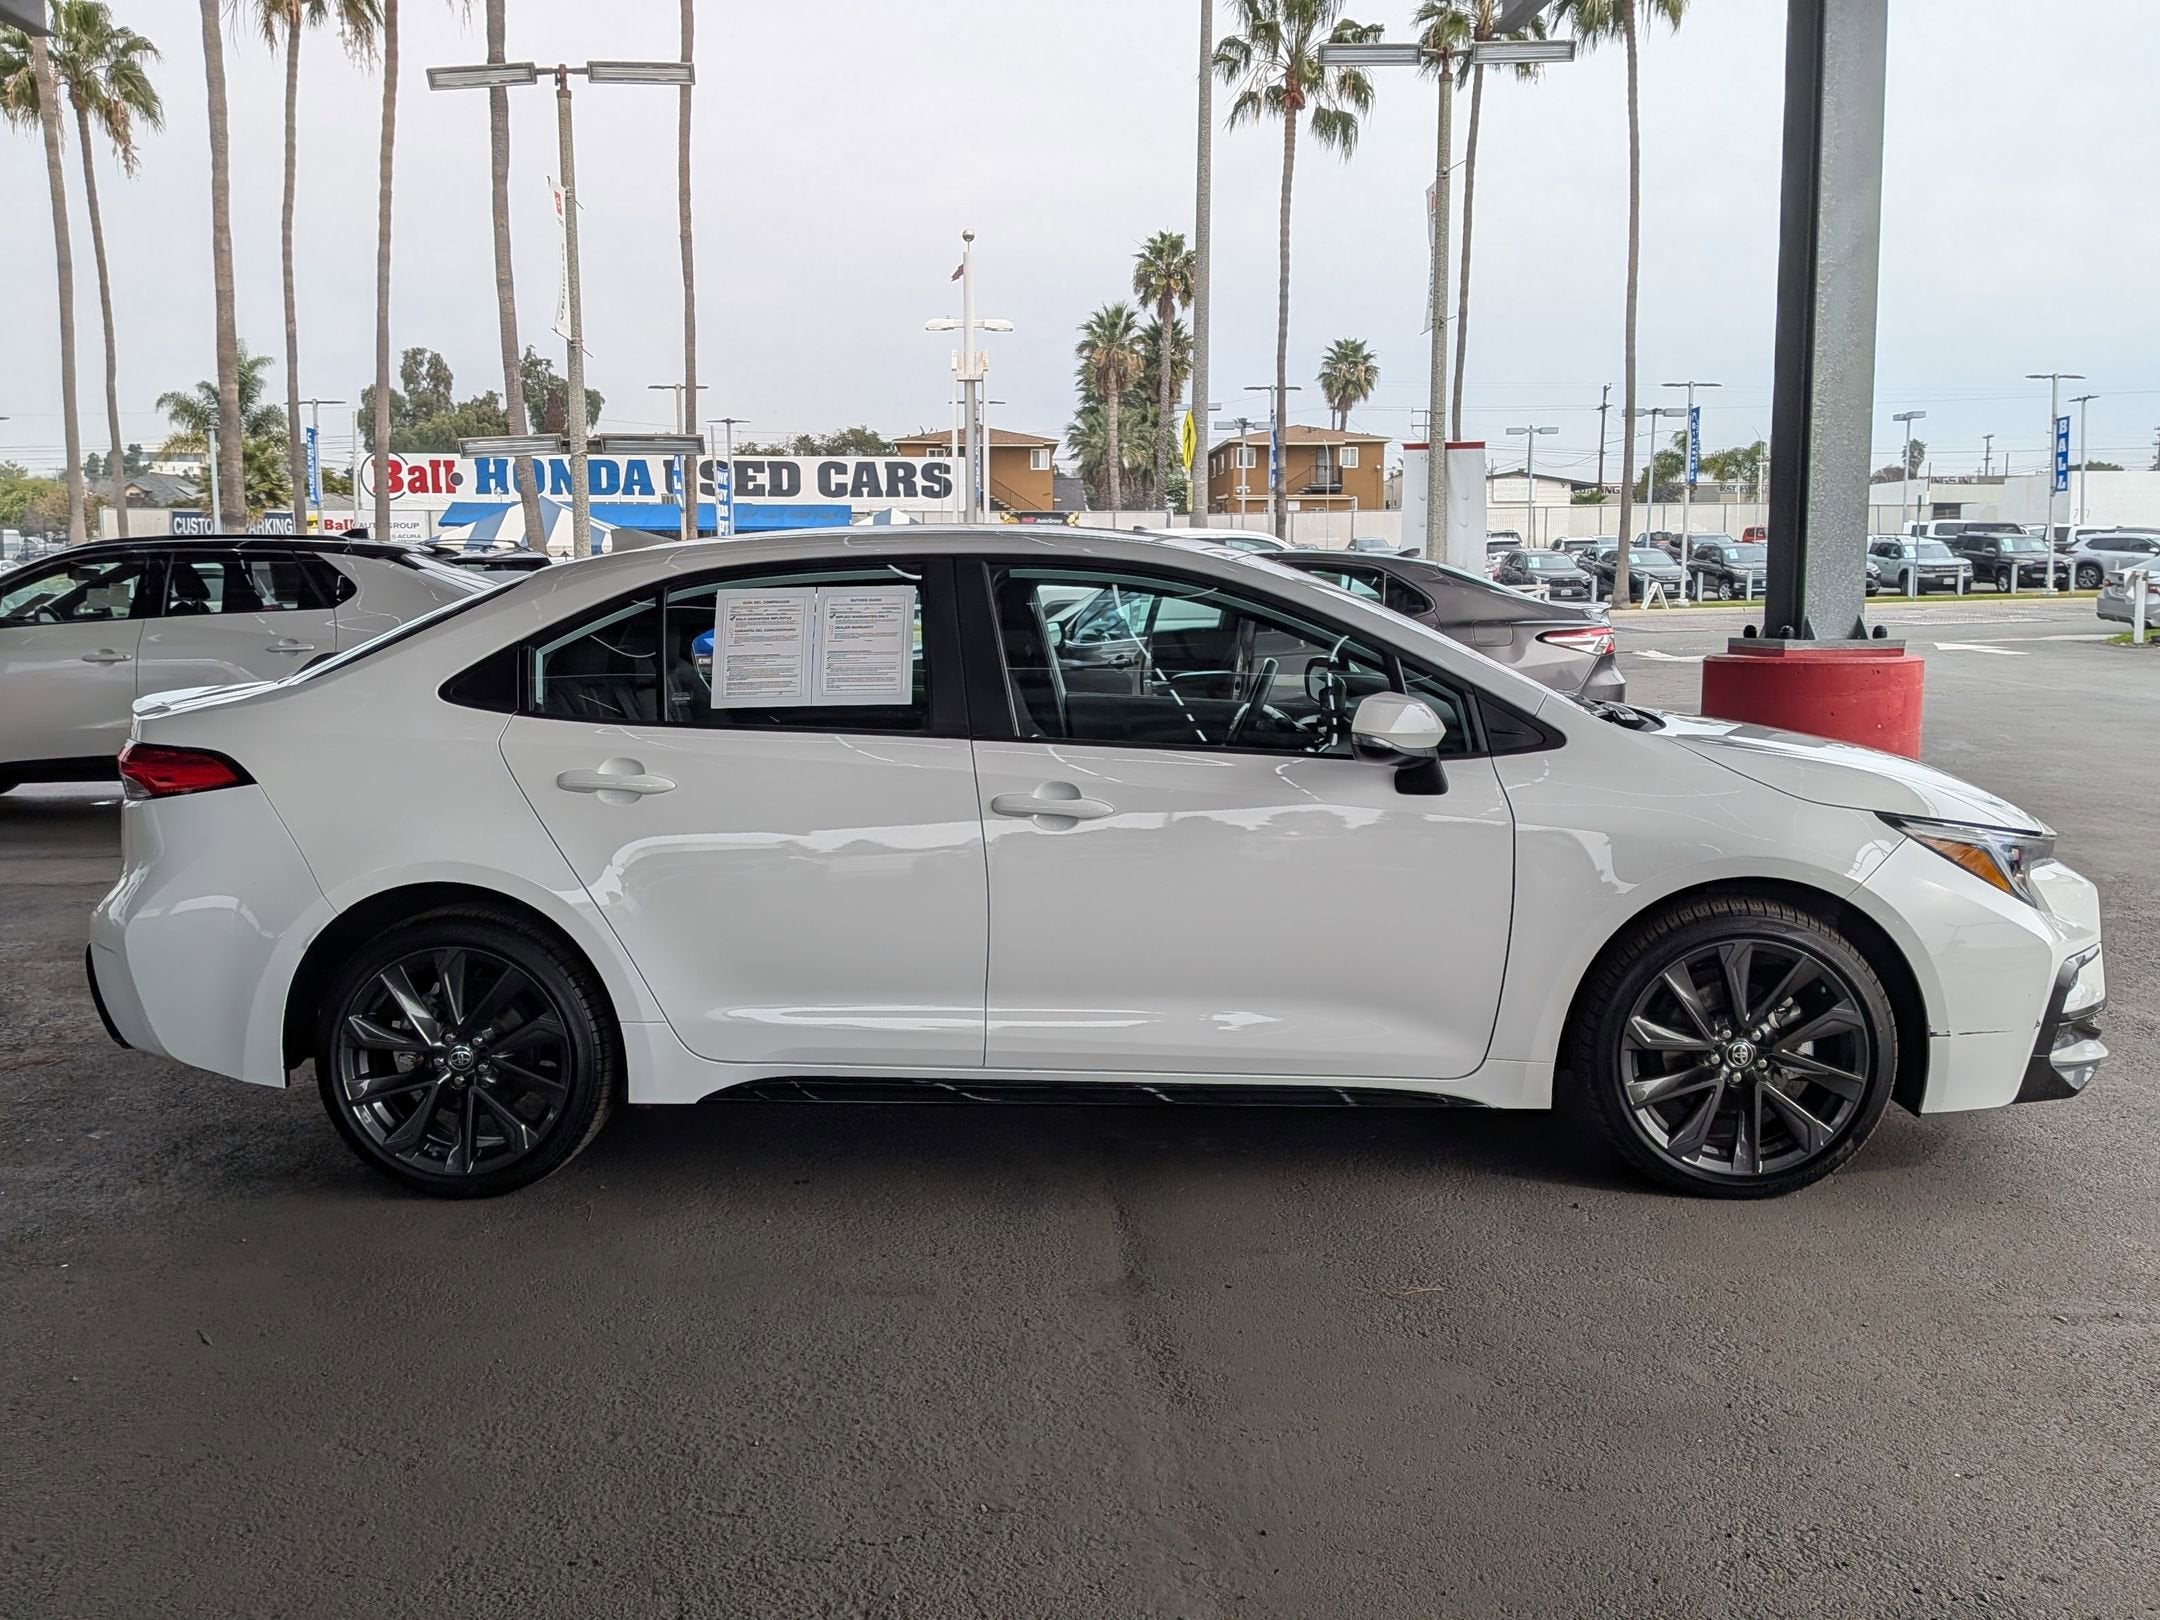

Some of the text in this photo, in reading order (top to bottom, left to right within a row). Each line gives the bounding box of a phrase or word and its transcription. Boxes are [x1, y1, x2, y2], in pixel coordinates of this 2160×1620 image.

[2057, 419, 2067, 490] BALL
[370, 459, 457, 494] Ball
[474, 457, 655, 496] HONDA
[817, 460, 952, 499] CARS
[246, 518, 293, 535] ARKING
